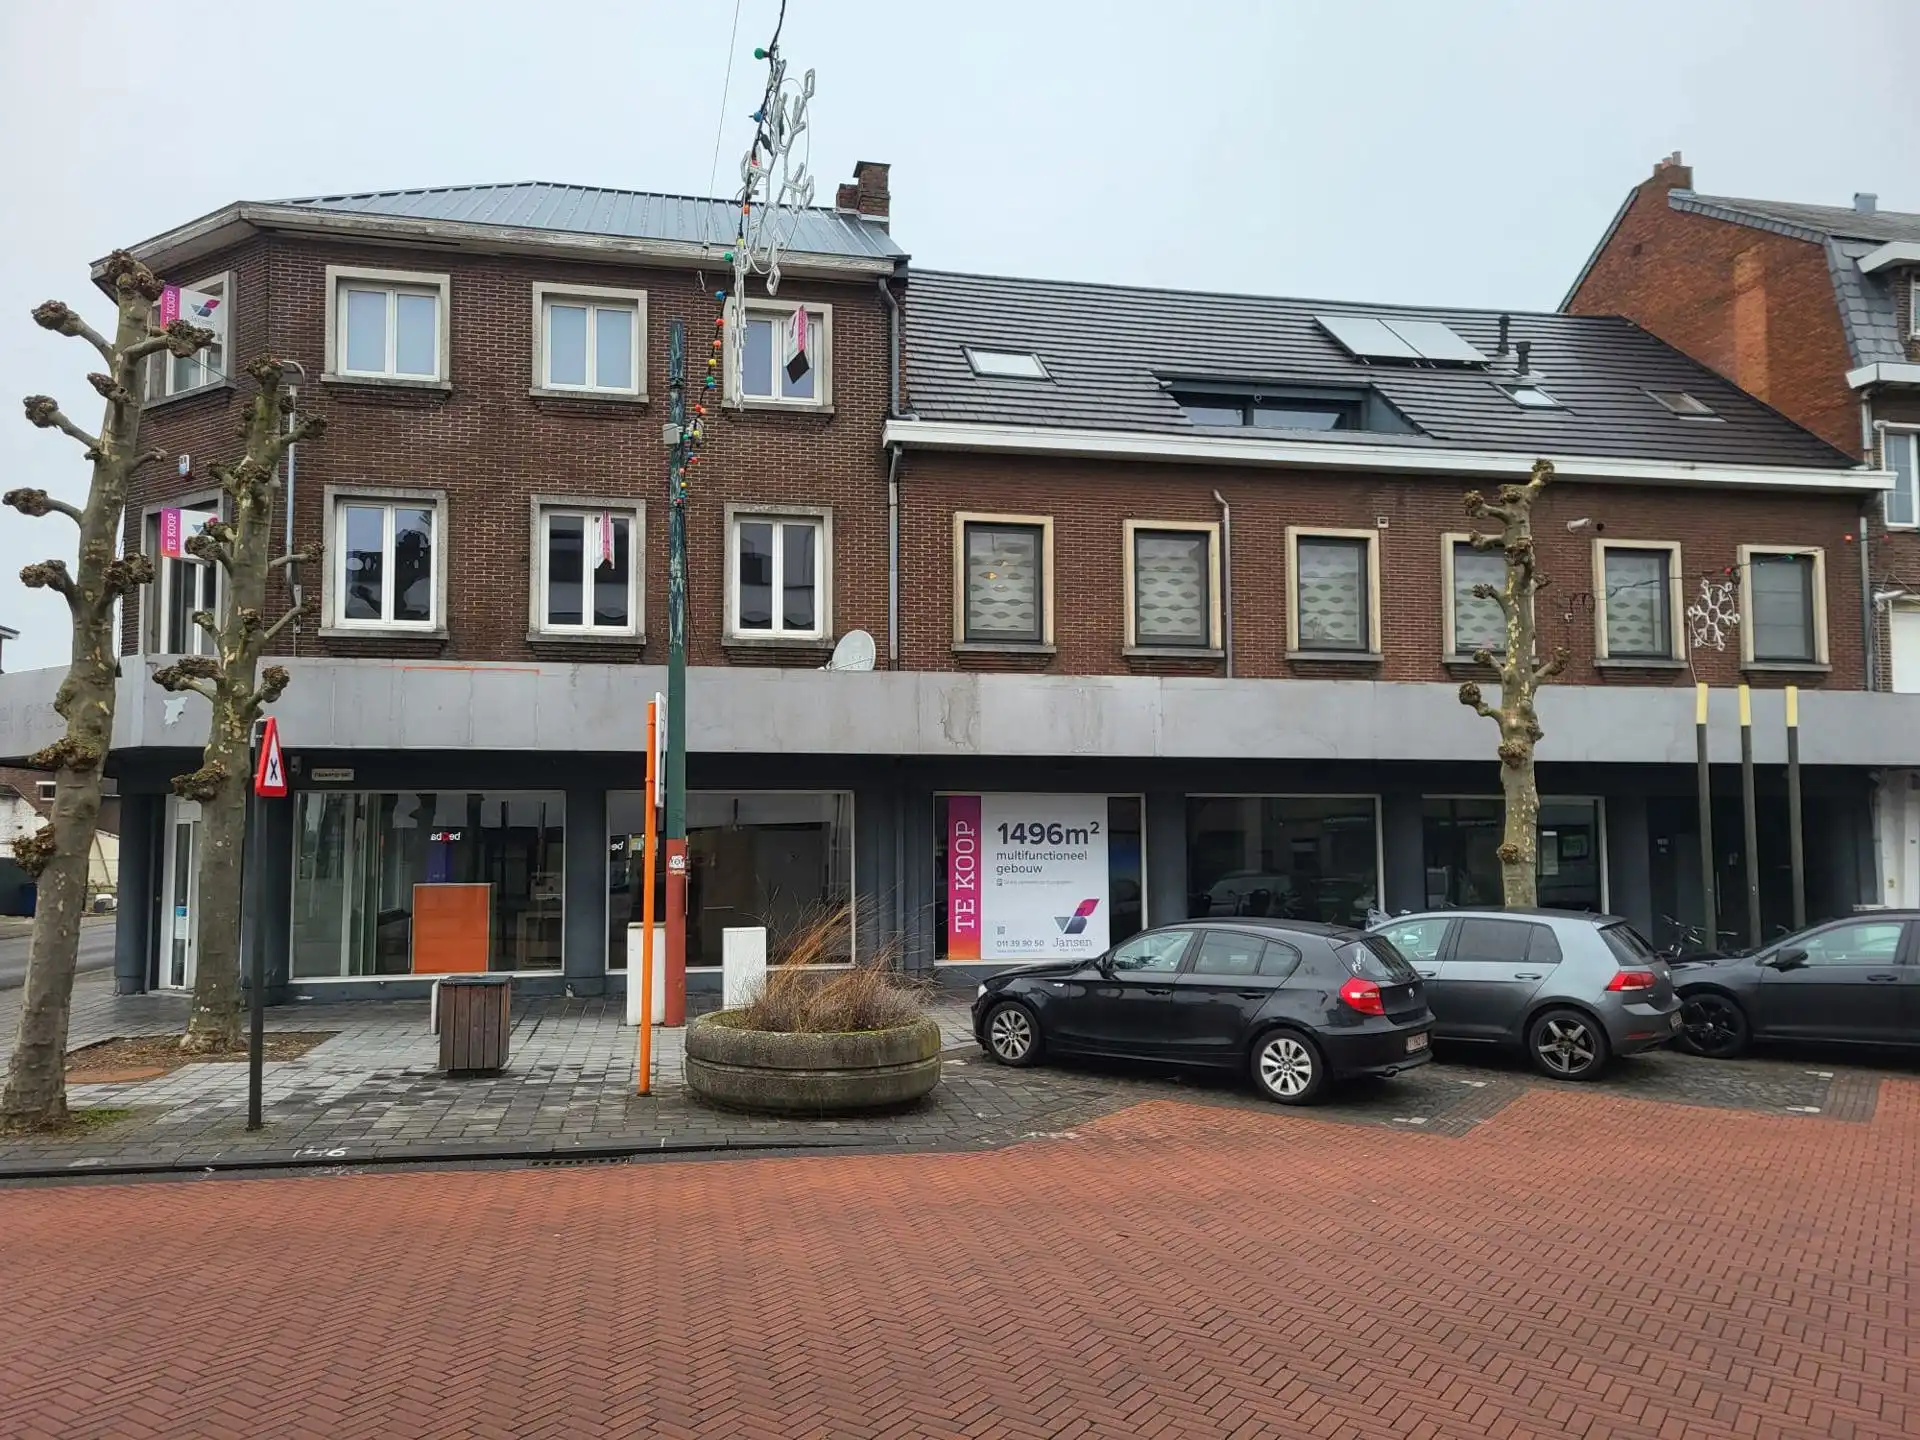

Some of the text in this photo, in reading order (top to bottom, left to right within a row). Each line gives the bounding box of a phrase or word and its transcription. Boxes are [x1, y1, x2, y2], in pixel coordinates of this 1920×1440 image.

[167, 512, 176, 552] TE KOOP
[996, 850, 1088, 861] multifunctioneel
[996, 864, 1043, 876] gebouw
[955, 820, 975, 933] TE KOOP
[1034, 940, 1044, 948] 50
[1052, 937, 1092, 948] Jansen
